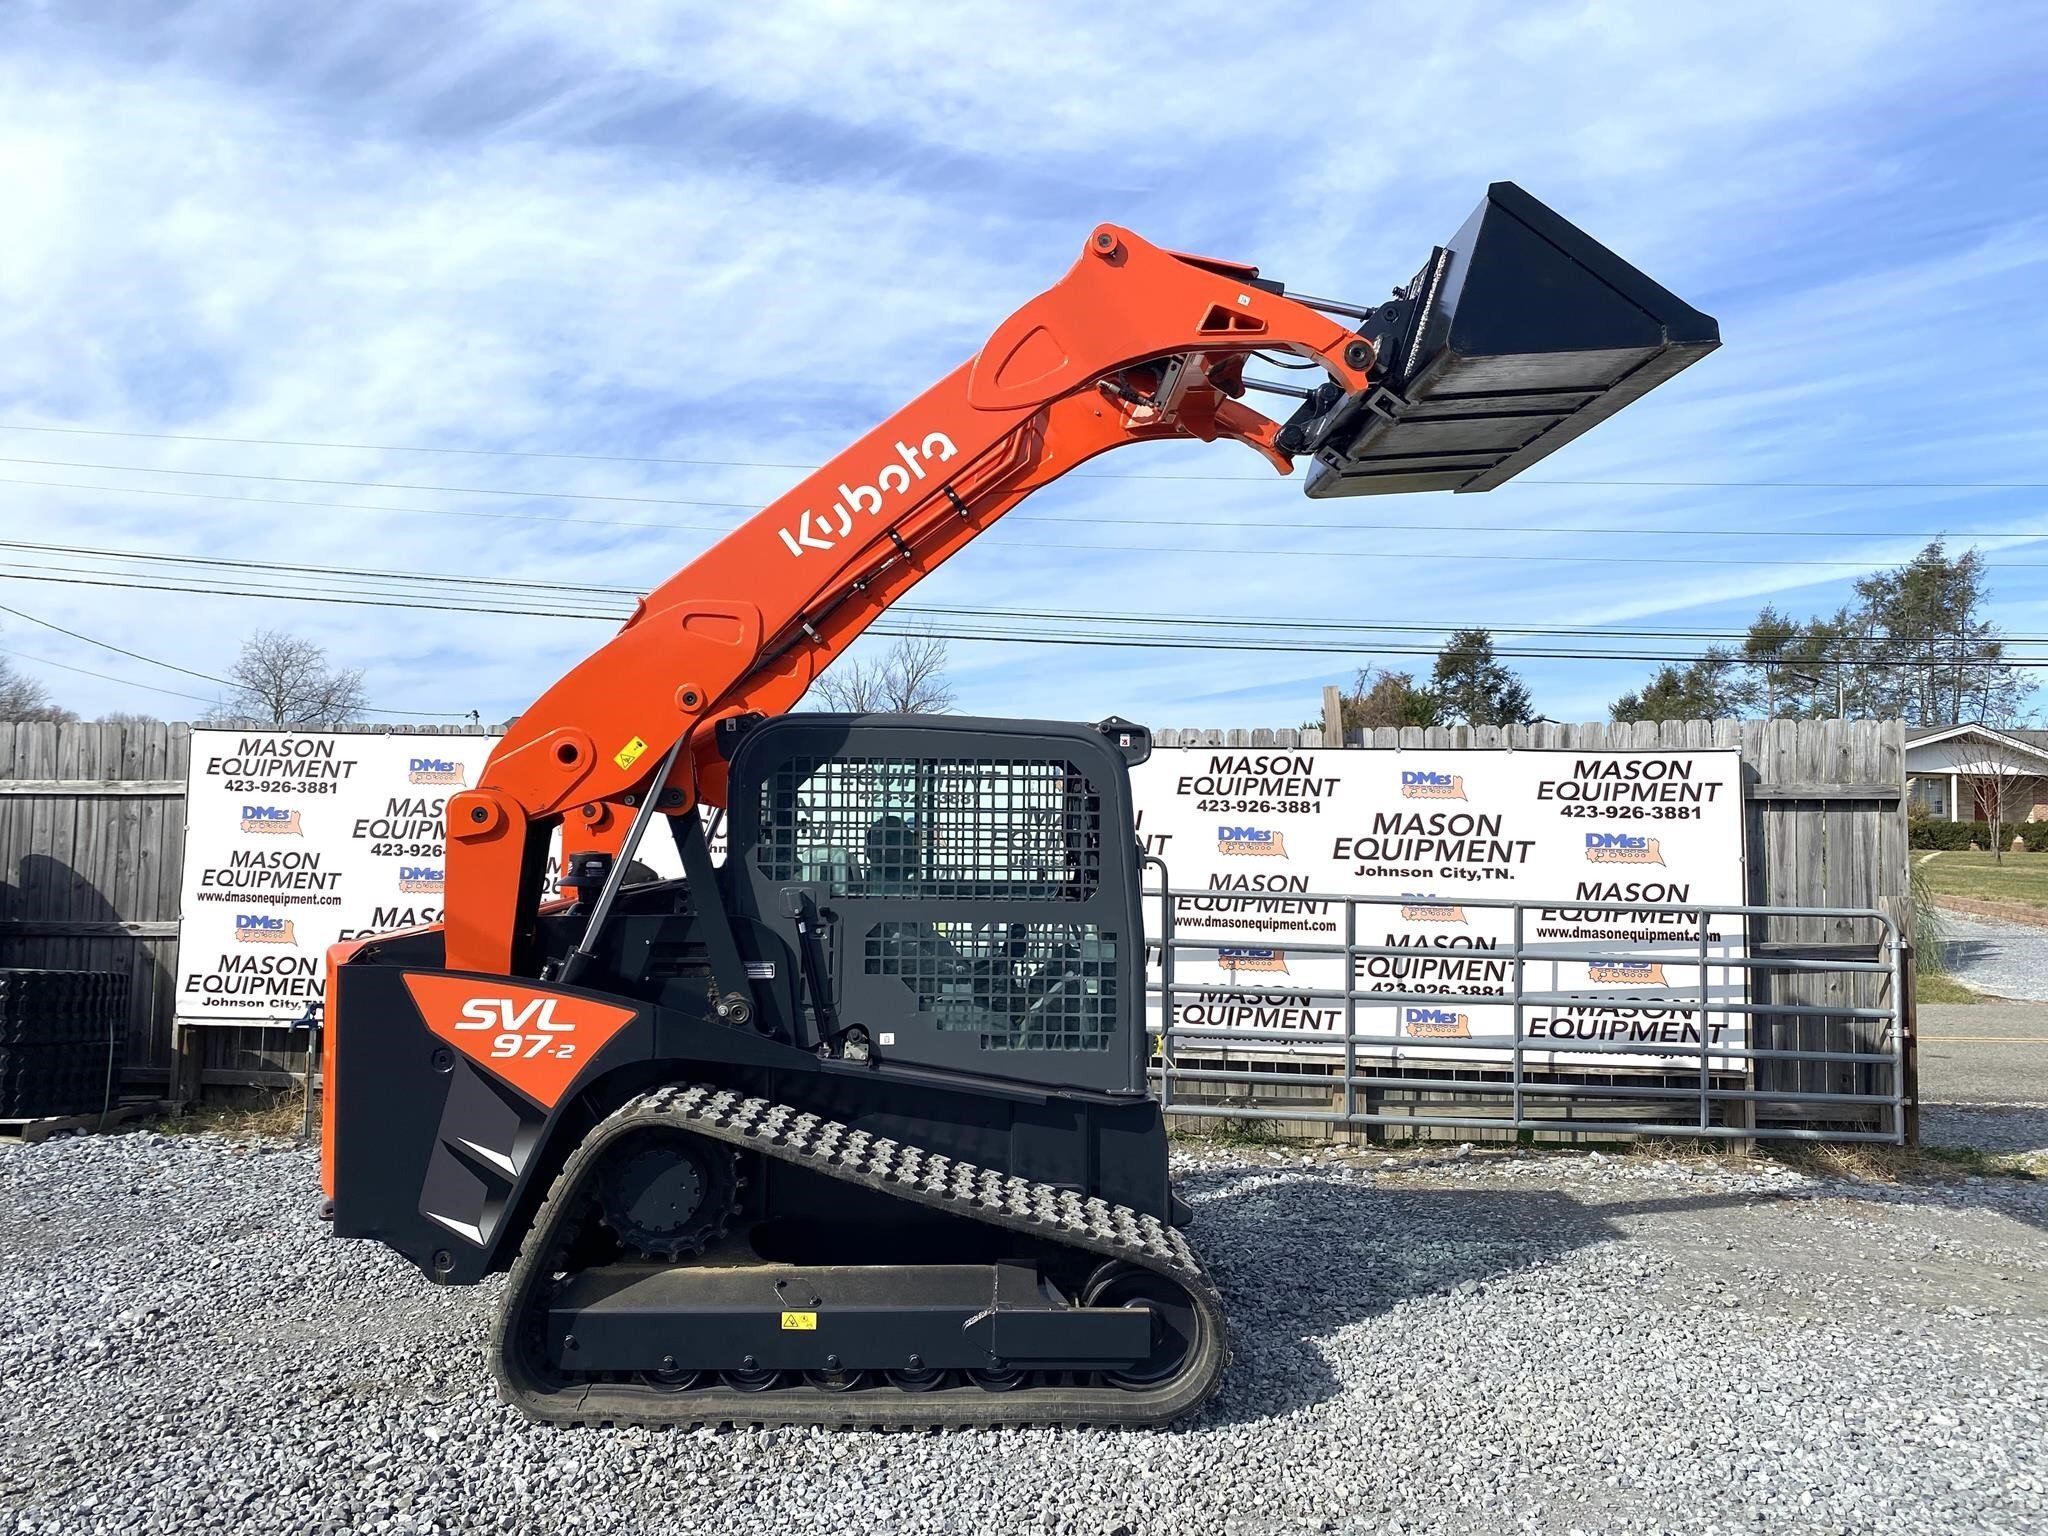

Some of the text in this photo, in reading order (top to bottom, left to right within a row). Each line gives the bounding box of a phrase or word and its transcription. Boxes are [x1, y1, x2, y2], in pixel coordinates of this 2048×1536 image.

[777, 431, 959, 558] Kubota
[237, 738, 335, 758] MASON
[206, 757, 358, 779] EQUIPMENT
[1208, 755, 1314, 776] MASON
[1573, 760, 1693, 780] MASON
[224, 779, 338, 794] 423-926-3881
[1176, 776, 1341, 797] EQUIPMENT
[1536, 781, 1723, 802] EQUIPMENT
[385, 797, 446, 818] MAS
[1196, 799, 1321, 814] 423-926-3881
[1560, 805, 1701, 820] 423-926-3881
[1372, 812, 1502, 837] MASON
[230, 850, 321, 870] MASON
[370, 843, 447, 858] 423-926-
[1332, 837, 1536, 864] EQUIPMENT
[201, 869, 342, 890] EQUIPMENT
[1208, 873, 1309, 893] MASON
[1354, 865, 1515, 882] Johnson City,TN.
[197, 891, 342, 907] www.dmasonequipment.com
[1575, 881, 1690, 903] MASON
[371, 906, 444, 928] MAS
[217, 954, 318, 976] MASON
[185, 973, 326, 997] EQUIPMEN
[201, 996, 264, 1008] Johnson
[454, 998, 576, 1031] SVL
[490, 1033, 576, 1059] 97-2
